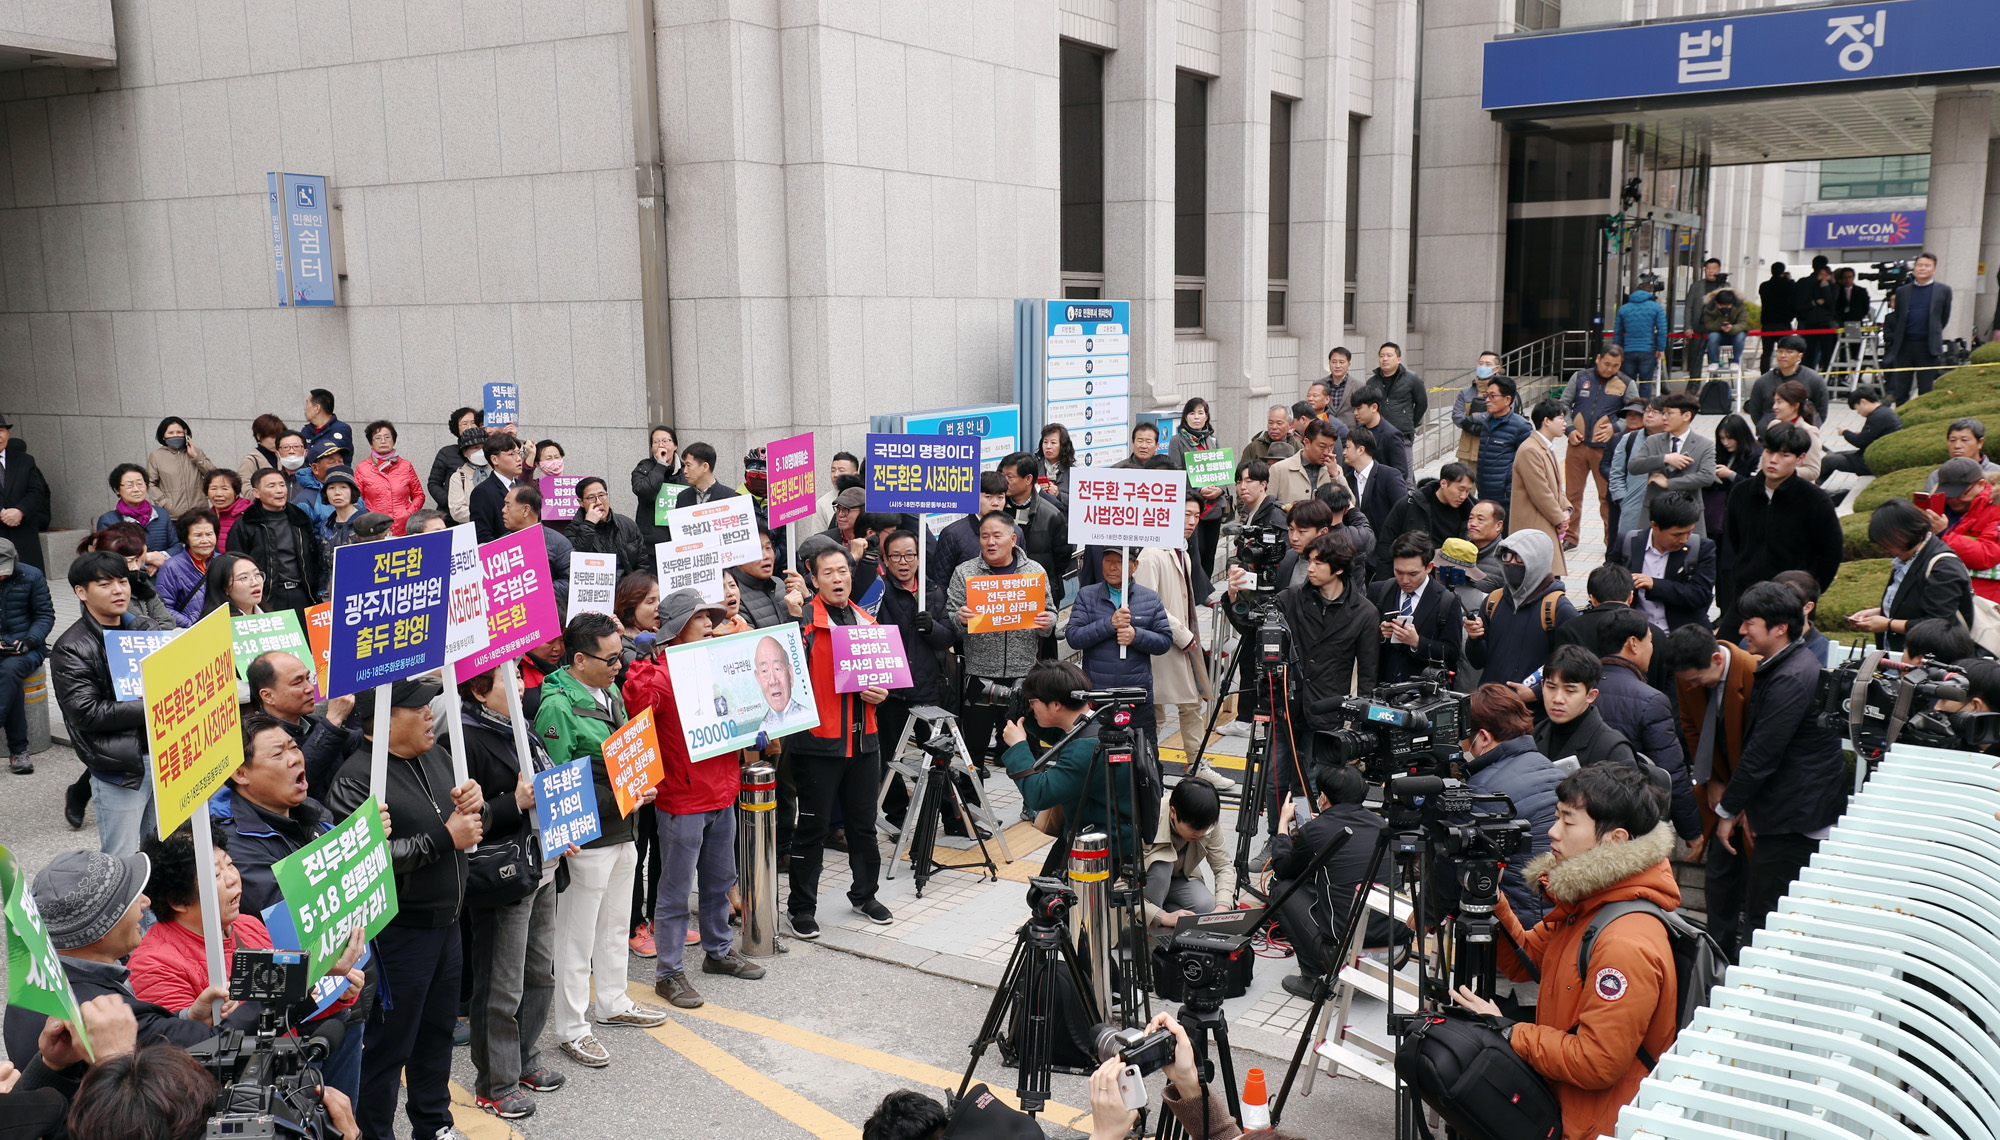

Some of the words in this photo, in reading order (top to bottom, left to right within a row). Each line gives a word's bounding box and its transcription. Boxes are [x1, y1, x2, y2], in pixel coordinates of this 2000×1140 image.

[292, 214, 322, 227] 민원인
[1828, 222, 1894, 240] LAWCOM
[298, 230, 322, 282] 쉼터
[488, 412, 510, 424] 진실을
[874, 444, 915, 458] 국민의
[920, 444, 974, 459] 명령이다
[1193, 451, 1224, 462] 전두환은
[874, 464, 922, 492] 전두환은
[925, 466, 974, 492] 사죄하라
[1189, 464, 1204, 473] 5·18
[1196, 472, 1230, 483] 사죄하라!
[770, 478, 788, 506] 전두환
[788, 474, 804, 501] 반드시
[1078, 481, 1119, 500] 전두환
[1123, 482, 1177, 503] 구속으로
[544, 498, 570, 506] 역사의
[558, 508, 578, 516] 받으
[682, 521, 711, 536] 학살자
[712, 513, 749, 531] 전두환은
[1084, 505, 1138, 526] 사법정의
[1143, 507, 1170, 527] 실현
[722, 529, 750, 545] 받으라
[374, 546, 423, 584] 전두환
[662, 557, 691, 574] 전두환은
[693, 552, 719, 568] 사죄하고
[492, 568, 538, 606] 주범은
[574, 572, 595, 585] 전두환은
[595, 573, 614, 586] 사죄하고
[670, 573, 692, 589] 죄값을
[693, 568, 715, 584] 받으라!
[971, 580, 999, 591] 국민의
[1002, 578, 1041, 589] 명령이다.
[345, 576, 442, 626] 광주지방법원
[449, 581, 482, 626] 사죄하라
[987, 590, 1026, 602] 전두환은
[975, 604, 1005, 614] 역사의
[1009, 601, 1038, 612] 심판을
[235, 616, 285, 636] 전두환은
[992, 614, 1021, 626] 받으라
[232, 639, 259, 655] 5·18
[259, 632, 302, 651] 영령앞에
[356, 623, 390, 660] 출두
[393, 613, 430, 650] 환영!
[848, 628, 887, 640] 전두환은
[787, 633, 802, 675] 290000
[850, 643, 891, 656] 참회하고
[723, 659, 752, 675] 이십구만원
[840, 658, 872, 671] 역사의
[875, 656, 904, 669] 심판을
[857, 672, 894, 686] 받으라!
[152, 678, 195, 741] 전두환은
[195, 664, 215, 706] 진실
[215, 648, 234, 691] 앞에
[158, 741, 181, 788] 무릎
[182, 724, 202, 771] 꿇고
[203, 693, 237, 750] 사죄하라
[605, 735, 624, 758] 국민의
[624, 715, 652, 744] 명령이다.
[688, 719, 738, 749] 290000
[617, 738, 645, 768] 전두환은
[615, 764, 634, 788] 역사의
[634, 747, 656, 774] 심판을
[543, 766, 582, 798] 전두환은
[627, 771, 649, 798] 받으라
[550, 791, 582, 820] 5·18의
[544, 824, 570, 852] 진실을
[570, 812, 596, 841] 밝혀라
[302, 816, 371, 886] 전두환은
[299, 885, 340, 933] 5·18
[341, 841, 388, 903] 영령앞에
[318, 882, 388, 963] 사죄하라!
